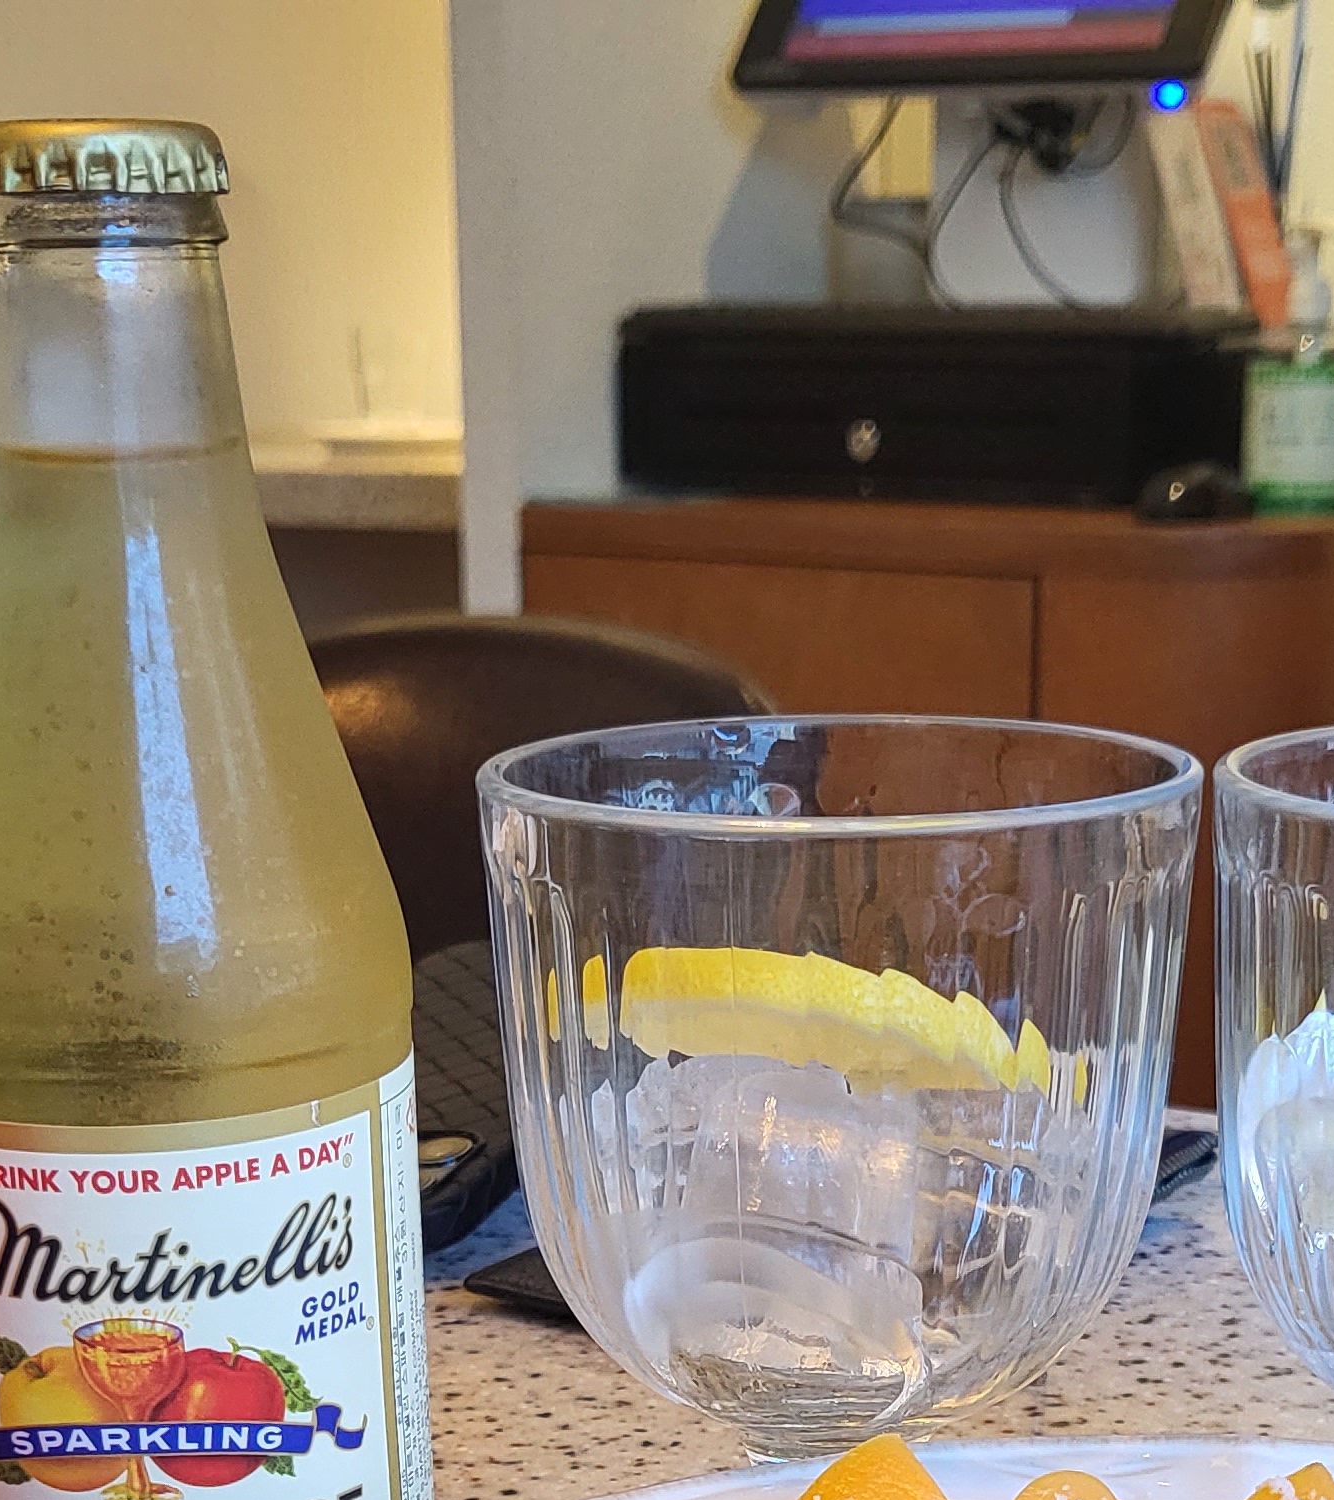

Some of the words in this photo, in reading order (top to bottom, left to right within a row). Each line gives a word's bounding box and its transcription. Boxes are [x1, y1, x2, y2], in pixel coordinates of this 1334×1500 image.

[69, 1169, 162, 1195] YOUR
[171, 1157, 261, 1192] APPLE
[270, 1153, 290, 1177] A
[301, 1281, 360, 1319] GOLD
[295, 1302, 367, 1346] MEDAL
[10, 1426, 284, 1456] SPARKLING
